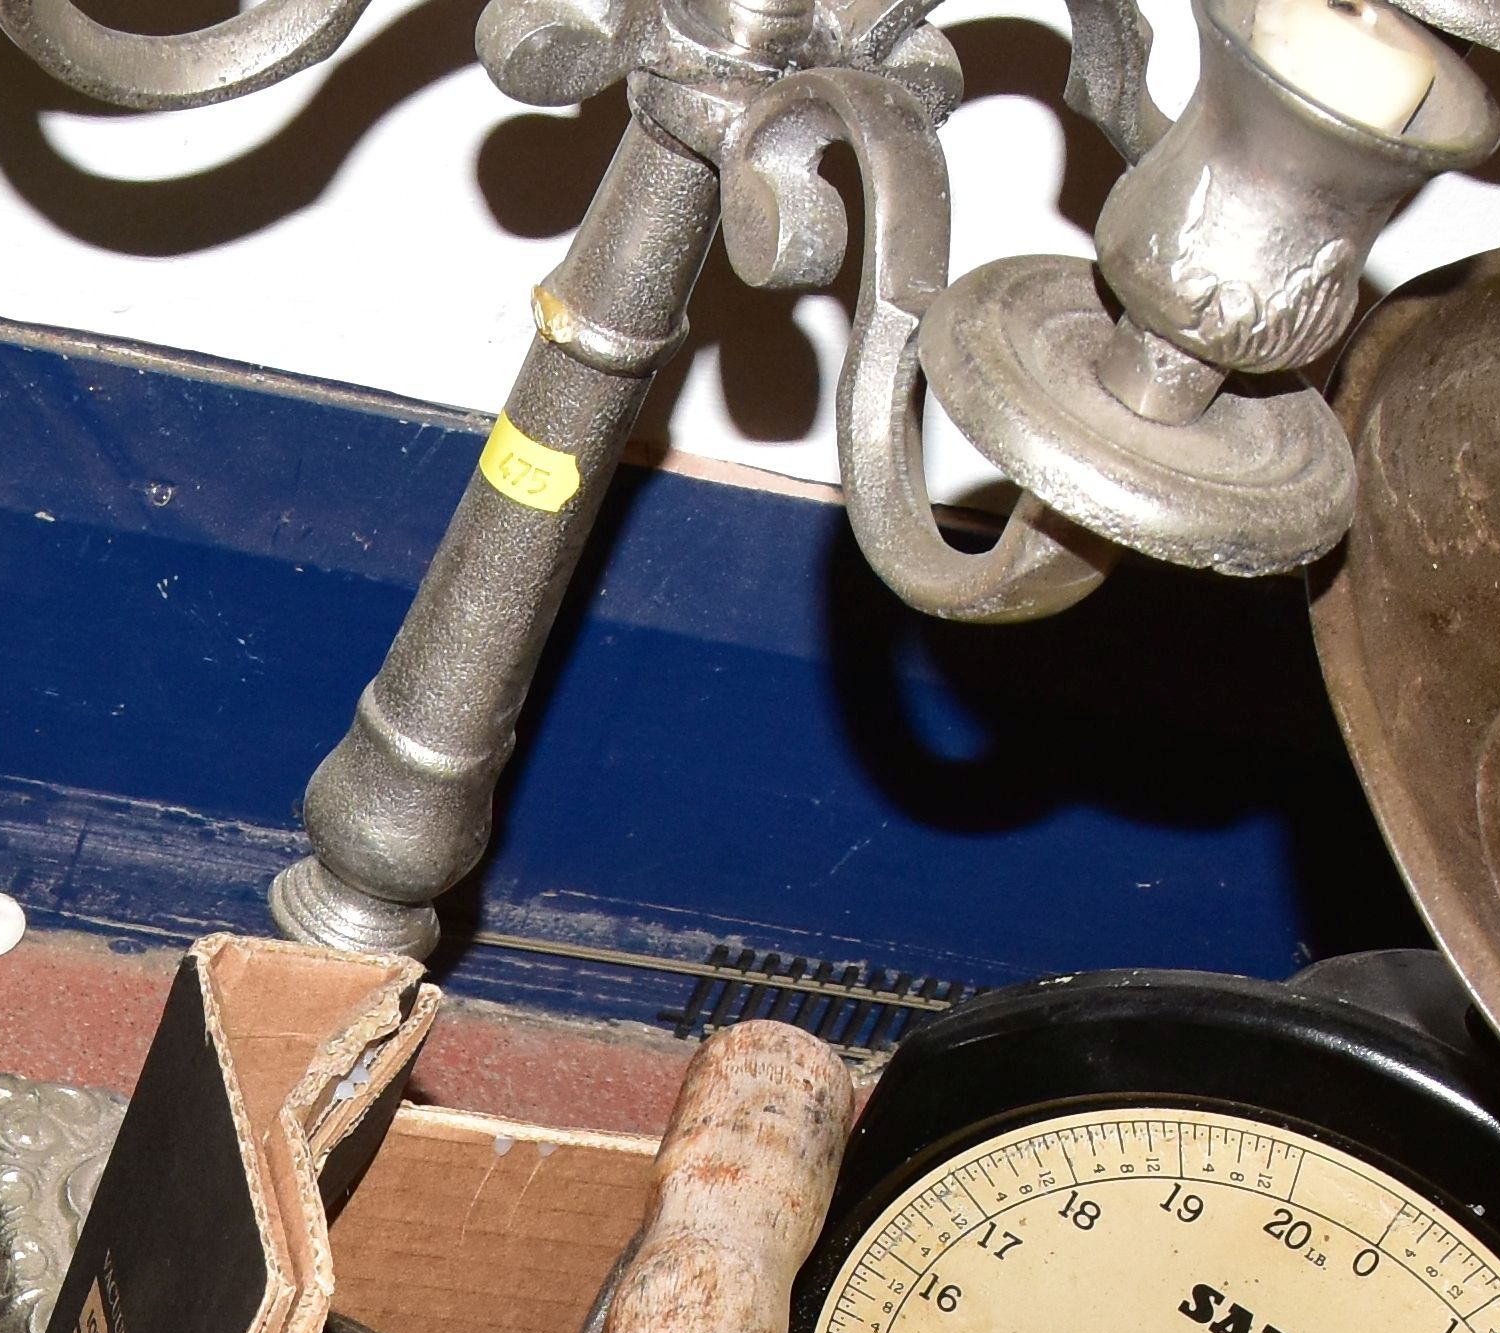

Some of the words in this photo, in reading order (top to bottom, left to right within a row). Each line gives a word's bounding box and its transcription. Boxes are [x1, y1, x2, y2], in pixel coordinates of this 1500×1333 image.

[499, 452, 551, 494] 475
[1094, 1164, 1105, 1173] 4
[1120, 1164, 1134, 1173] 8
[1146, 1158, 1160, 1172] 12
[1202, 1163, 1214, 1172] 4
[1039, 1171, 1055, 1187] 12
[1230, 1172, 1244, 1182] 8
[1258, 1173, 1272, 1188] 12
[1019, 1185, 1032, 1194] 8
[996, 1192, 1007, 1202] 4
[1160, 1183, 1203, 1222] 19
[1058, 1190, 1101, 1230] 18
[951, 1213, 967, 1229] 12
[1263, 1208, 1312, 1249] 20
[939, 1232, 950, 1245] 8
[977, 1222, 1023, 1260] 17
[921, 1247, 931, 1257] 4
[1405, 1249, 1416, 1257] 4
[1353, 1249, 1379, 1276] 0
[1426, 1266, 1438, 1277] 8
[888, 1279, 904, 1294] 12
[919, 1273, 961, 1312] 16
[1447, 1285, 1463, 1299] 12
[883, 1302, 893, 1313] 8
[871, 1323, 880, 1333] 4
